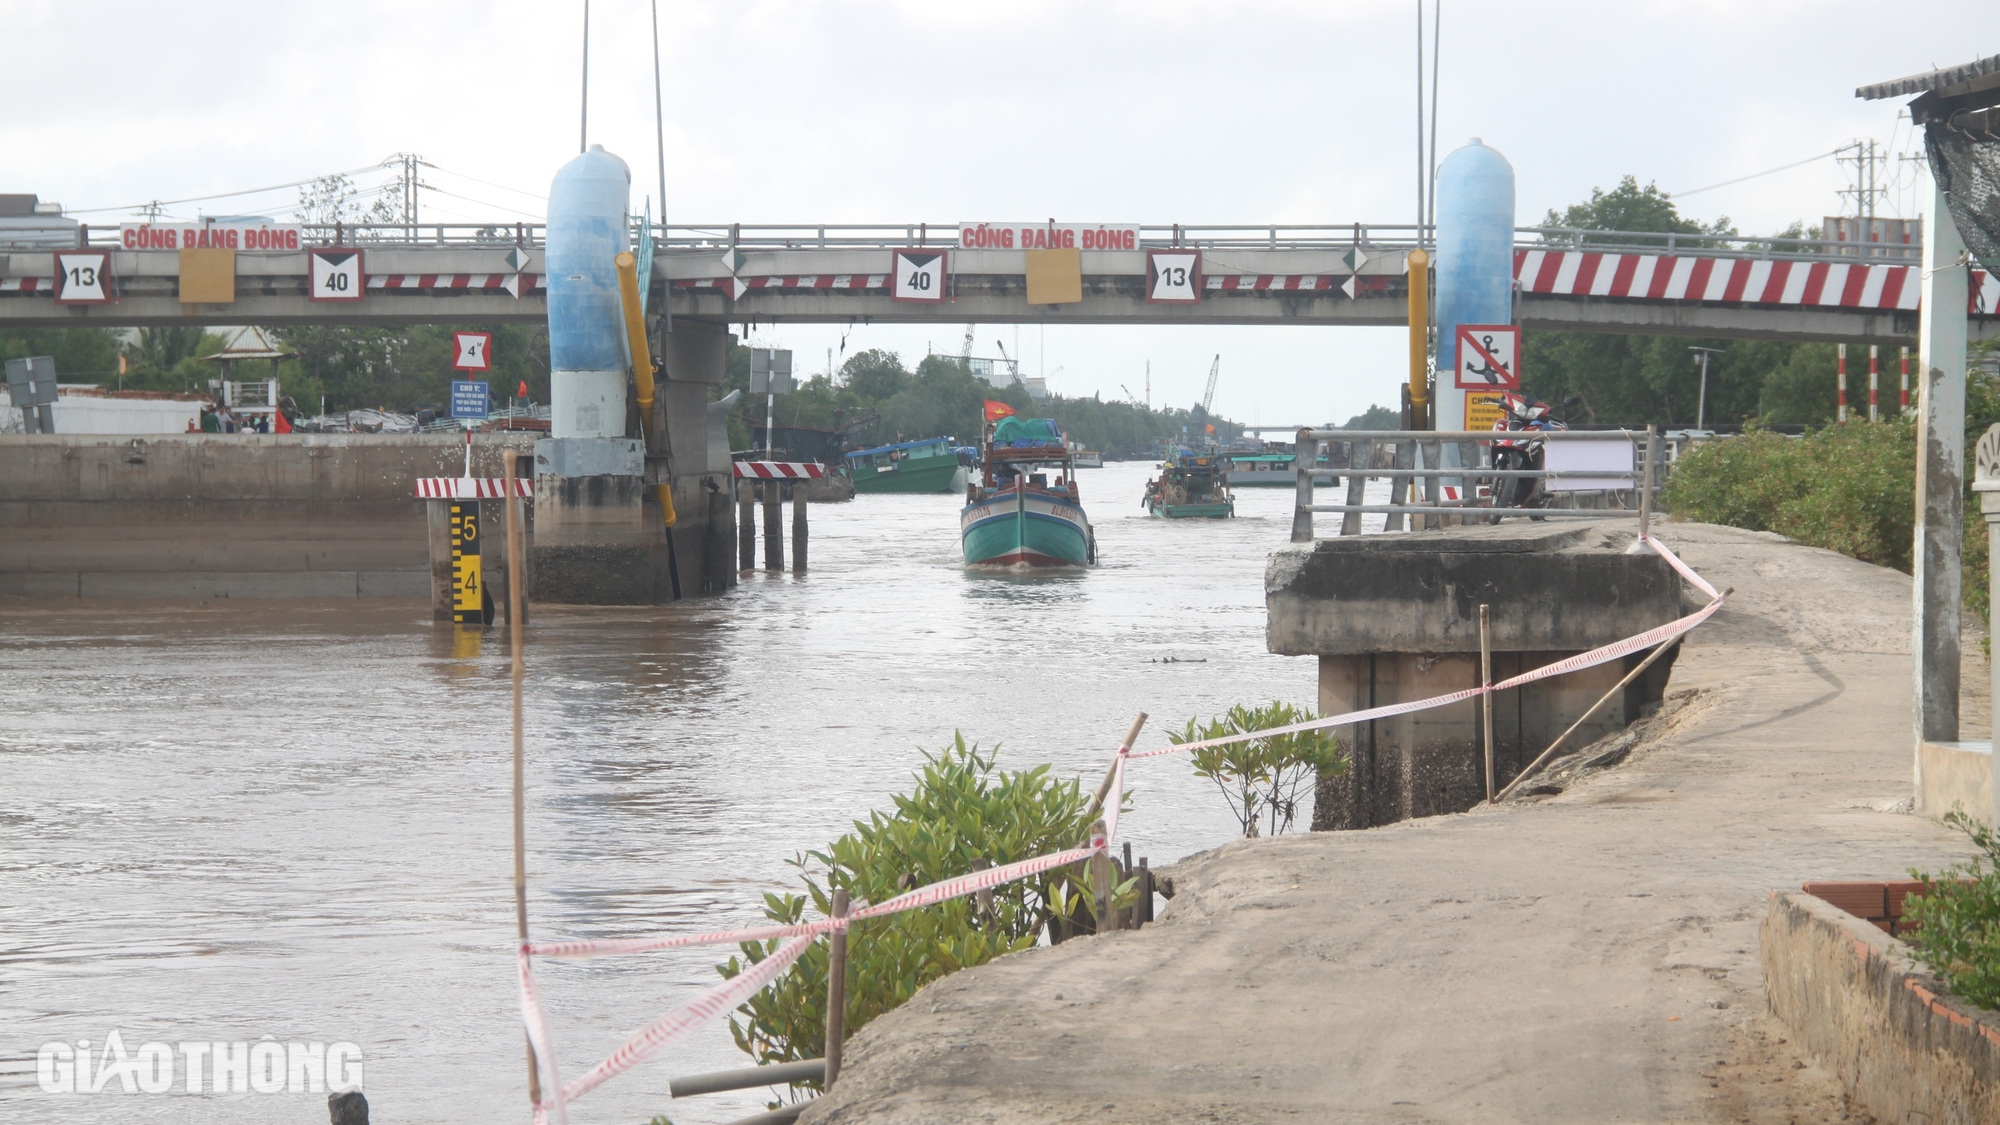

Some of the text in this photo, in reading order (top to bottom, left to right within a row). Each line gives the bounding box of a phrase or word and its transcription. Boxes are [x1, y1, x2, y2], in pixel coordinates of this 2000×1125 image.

[123, 223, 298, 249] CỐNG ĐANG ĐÓNG
[962, 222, 1135, 249] CỐNG ĐANG ĐÓNG
[70, 267, 95, 286] 13
[1161, 267, 1187, 287] 13
[463, 515, 477, 541] 5
[464, 570, 478, 595] 4
